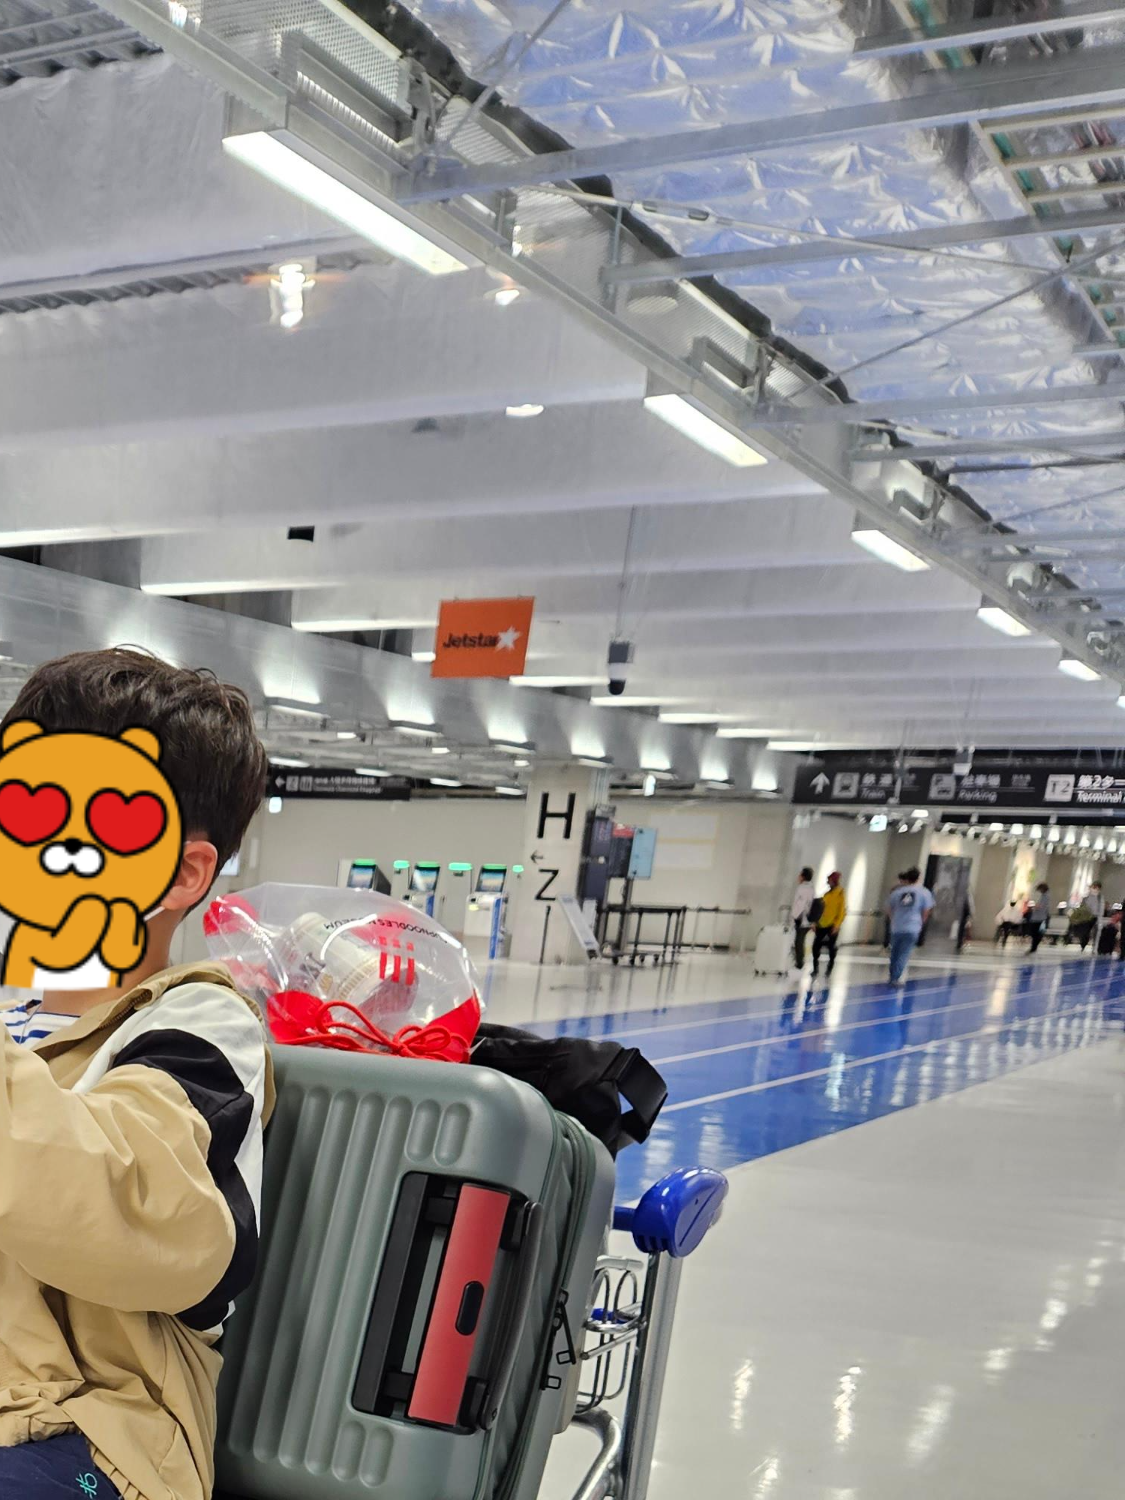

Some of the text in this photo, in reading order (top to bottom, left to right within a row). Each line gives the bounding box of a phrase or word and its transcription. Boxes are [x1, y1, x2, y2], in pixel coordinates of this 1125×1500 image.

[1051, 780, 1071, 793] T2
[1077, 790, 1122, 803] Terminal
[537, 792, 576, 839] H
[535, 869, 559, 901] Z
